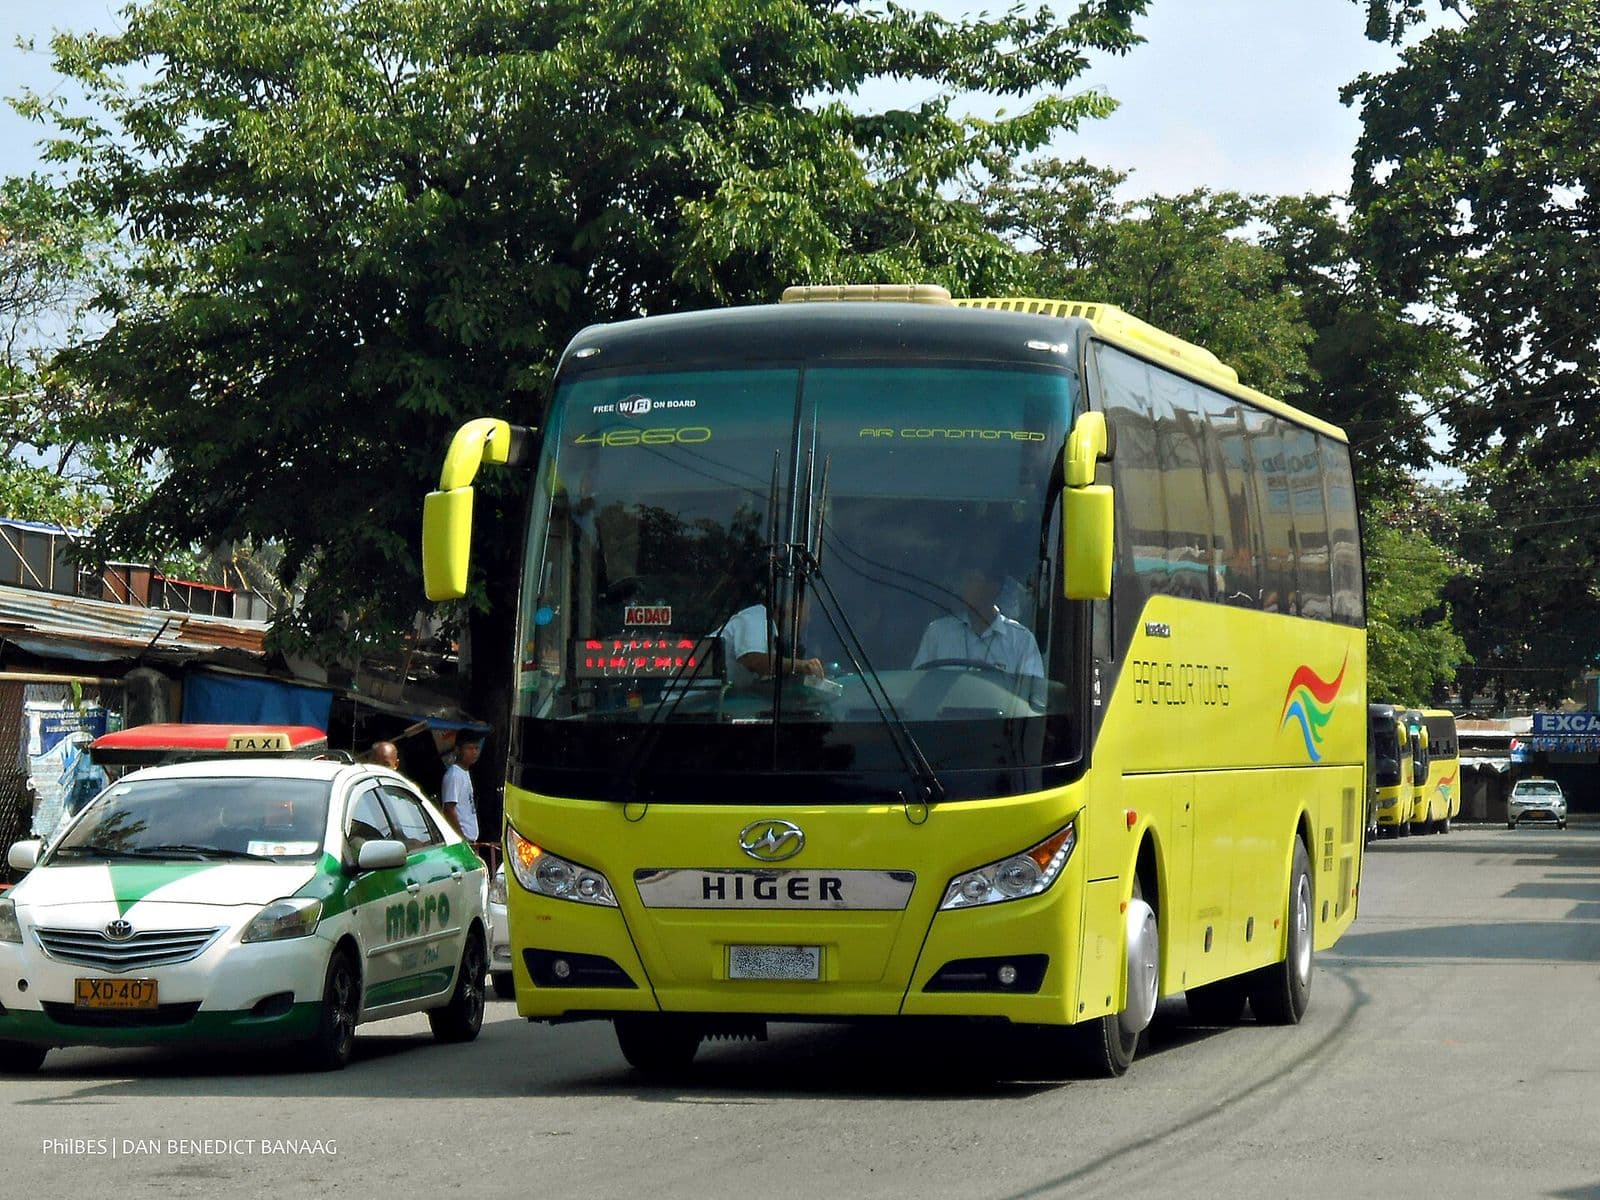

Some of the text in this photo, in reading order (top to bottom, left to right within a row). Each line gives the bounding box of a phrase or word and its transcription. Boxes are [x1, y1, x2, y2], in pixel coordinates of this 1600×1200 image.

[593, 403, 614, 414] FREE
[653, 401, 666, 409] ON
[667, 400, 696, 409] BOARD
[574, 426, 712, 447] 4660
[859, 427, 894, 438] AIR
[626, 607, 670, 624] AGDAO
[233, 739, 281, 749] TAXI
[702, 875, 845, 902] HIGER
